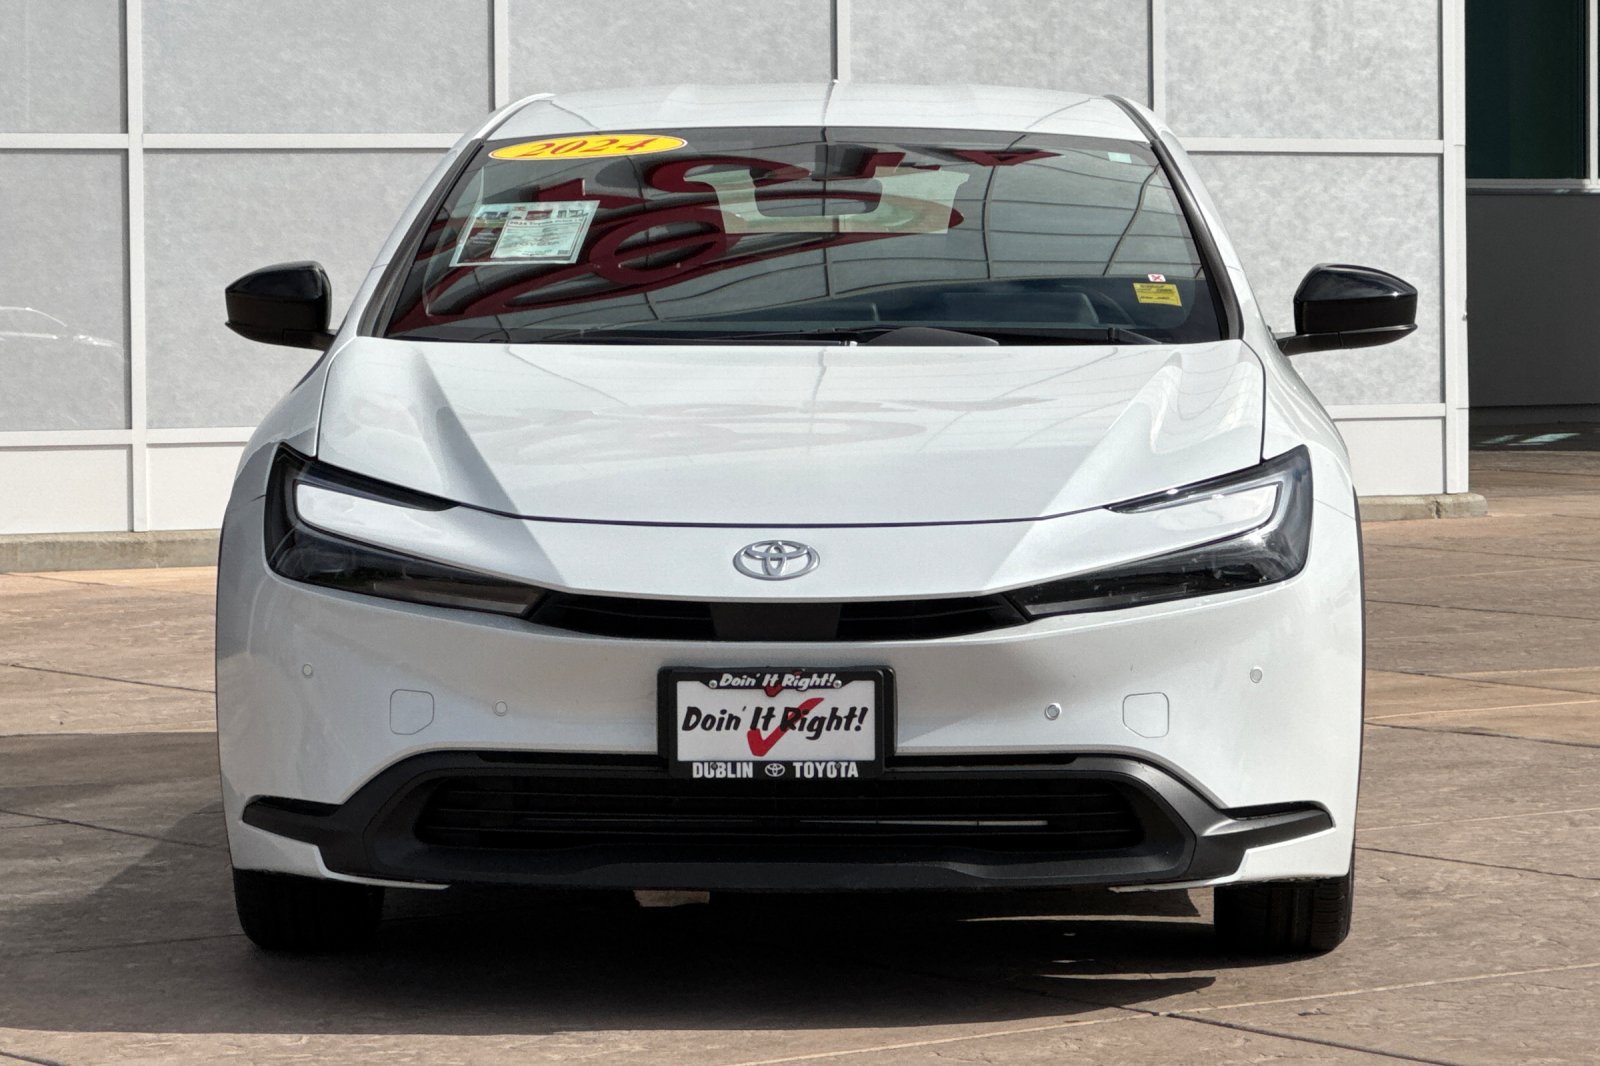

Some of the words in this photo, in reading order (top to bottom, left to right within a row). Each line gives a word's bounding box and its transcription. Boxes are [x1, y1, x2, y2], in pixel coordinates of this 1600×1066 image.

[515, 138, 659, 157] 2024
[719, 674, 761, 687] Doin'
[762, 674, 779, 687] It
[783, 673, 836, 691] Right!
[682, 706, 746, 731] Doin'
[750, 706, 776, 731] It
[780, 706, 868, 740] Right!
[692, 762, 753, 778] DUBLIN
[793, 762, 859, 778] TOYOTA
